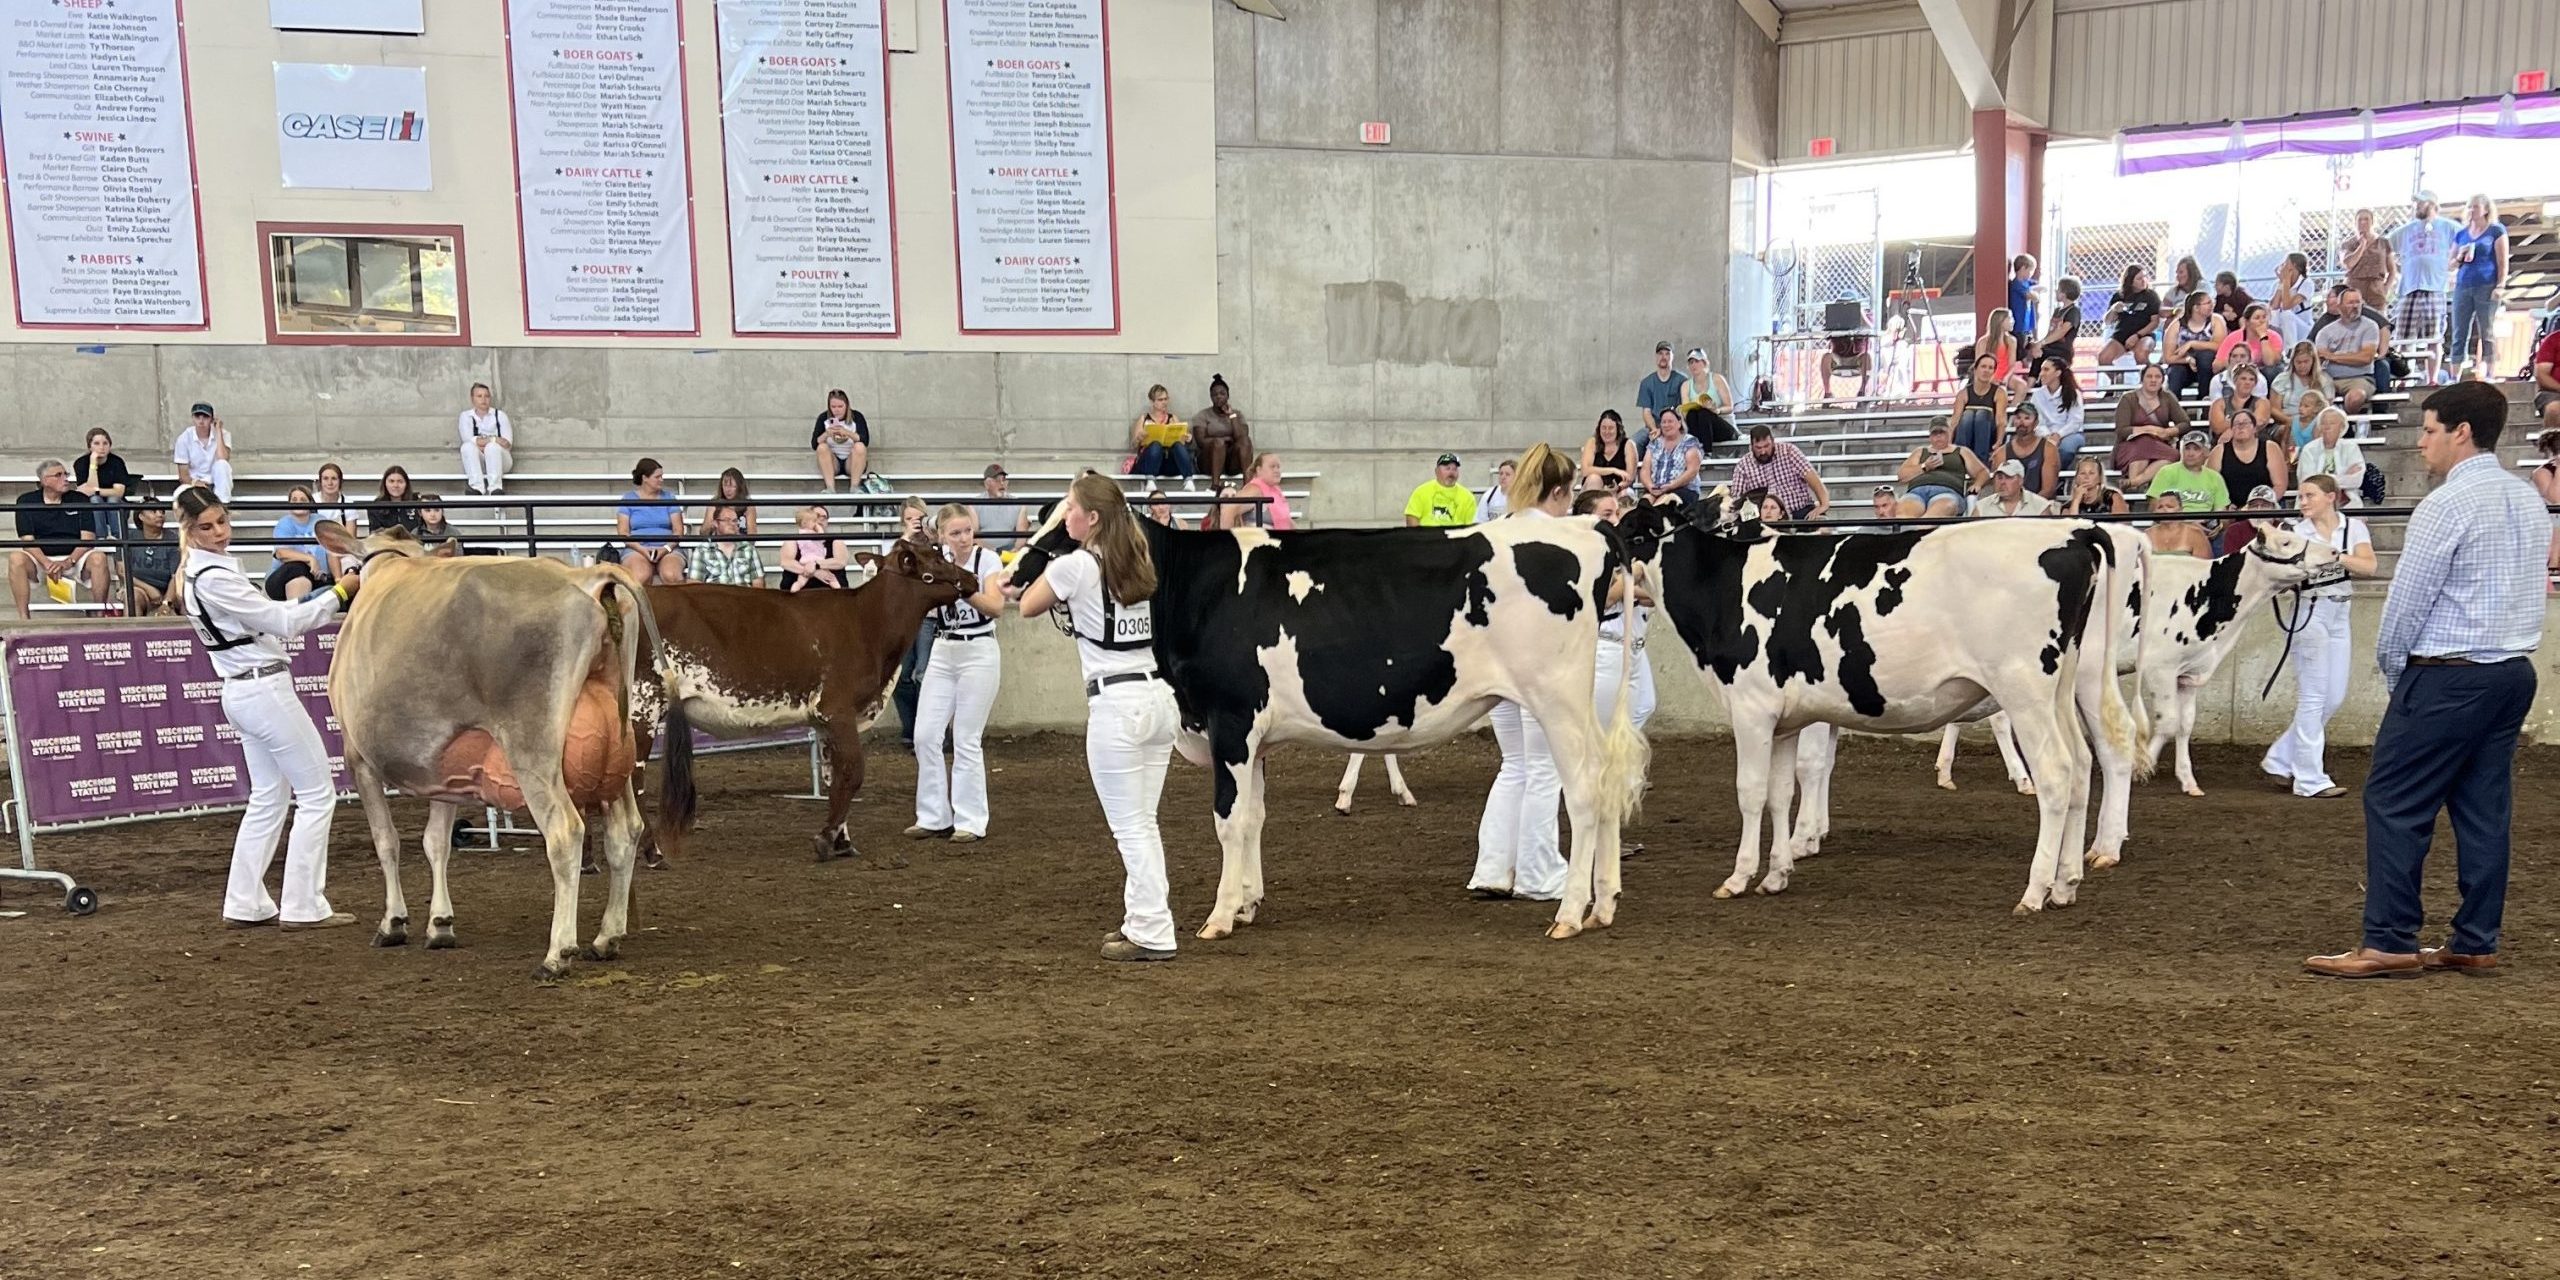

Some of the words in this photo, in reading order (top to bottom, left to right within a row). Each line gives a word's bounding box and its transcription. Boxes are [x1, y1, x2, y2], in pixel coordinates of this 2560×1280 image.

[564, 50, 593, 60] BOER
[596, 50, 632, 60] GOATS
[770, 56, 797, 66] BOER
[800, 57, 836, 67] GOATS
[998, 60, 1024, 69] BOER
[1027, 61, 1060, 70] GOATS
[283, 113, 387, 140] CASE
[75, 132, 113, 141] SWINE
[566, 168, 598, 177] DAIRY
[602, 168, 641, 178] CATTLE
[998, 168, 1028, 176] DAIRY
[1031, 168, 1068, 177] CATTLE
[774, 175, 806, 184] DAIRY
[810, 175, 848, 184] CATTLE
[81, 255, 132, 264] RABBITS
[1005, 257, 1034, 265] DAIRY
[1038, 257, 1070, 266] GOATS
[584, 265, 631, 274] POULTRY
[792, 270, 839, 279] POULTRY
[945, 608, 975, 621] 021
[1118, 617, 1149, 635] 0305
[83, 642, 131, 653] WISCONSIN
[146, 640, 192, 649] WISCONSIN
[17, 646, 68, 656] WISCONSIN
[85, 652, 112, 660] STATE
[113, 651, 131, 659] FAIR
[147, 648, 173, 657] STATE
[175, 647, 192, 656] FAIR
[19, 656, 46, 665] STATE
[48, 654, 69, 663] FAIR
[120, 684, 166, 694] WISCONSIN
[296, 684, 318, 692] STATE
[57, 688, 105, 699] WISCONSIN
[121, 694, 146, 703] STATE
[148, 693, 167, 701] FAIR
[184, 690, 206, 699] STATE
[58, 698, 86, 708] STATE
[88, 697, 105, 705] FAIR
[96, 730, 141, 741] WISCONSIN
[156, 726, 203, 736] WISCONSIN
[31, 736, 80, 747] WISCONSIN
[157, 735, 183, 744] STATE
[184, 734, 204, 742] FAIR
[97, 740, 122, 750] STATE
[124, 739, 142, 747] FAIR
[32, 746, 60, 756] STATE
[61, 745, 81, 753] FAIR
[191, 766, 236, 776] WISCONSIN
[132, 771, 178, 782] WISCONSIN
[192, 775, 219, 784] STATE
[221, 773, 237, 782] FAIR
[70, 777, 116, 789] WISCONSIN
[133, 781, 158, 791] STATE
[71, 788, 98, 798] STATE
